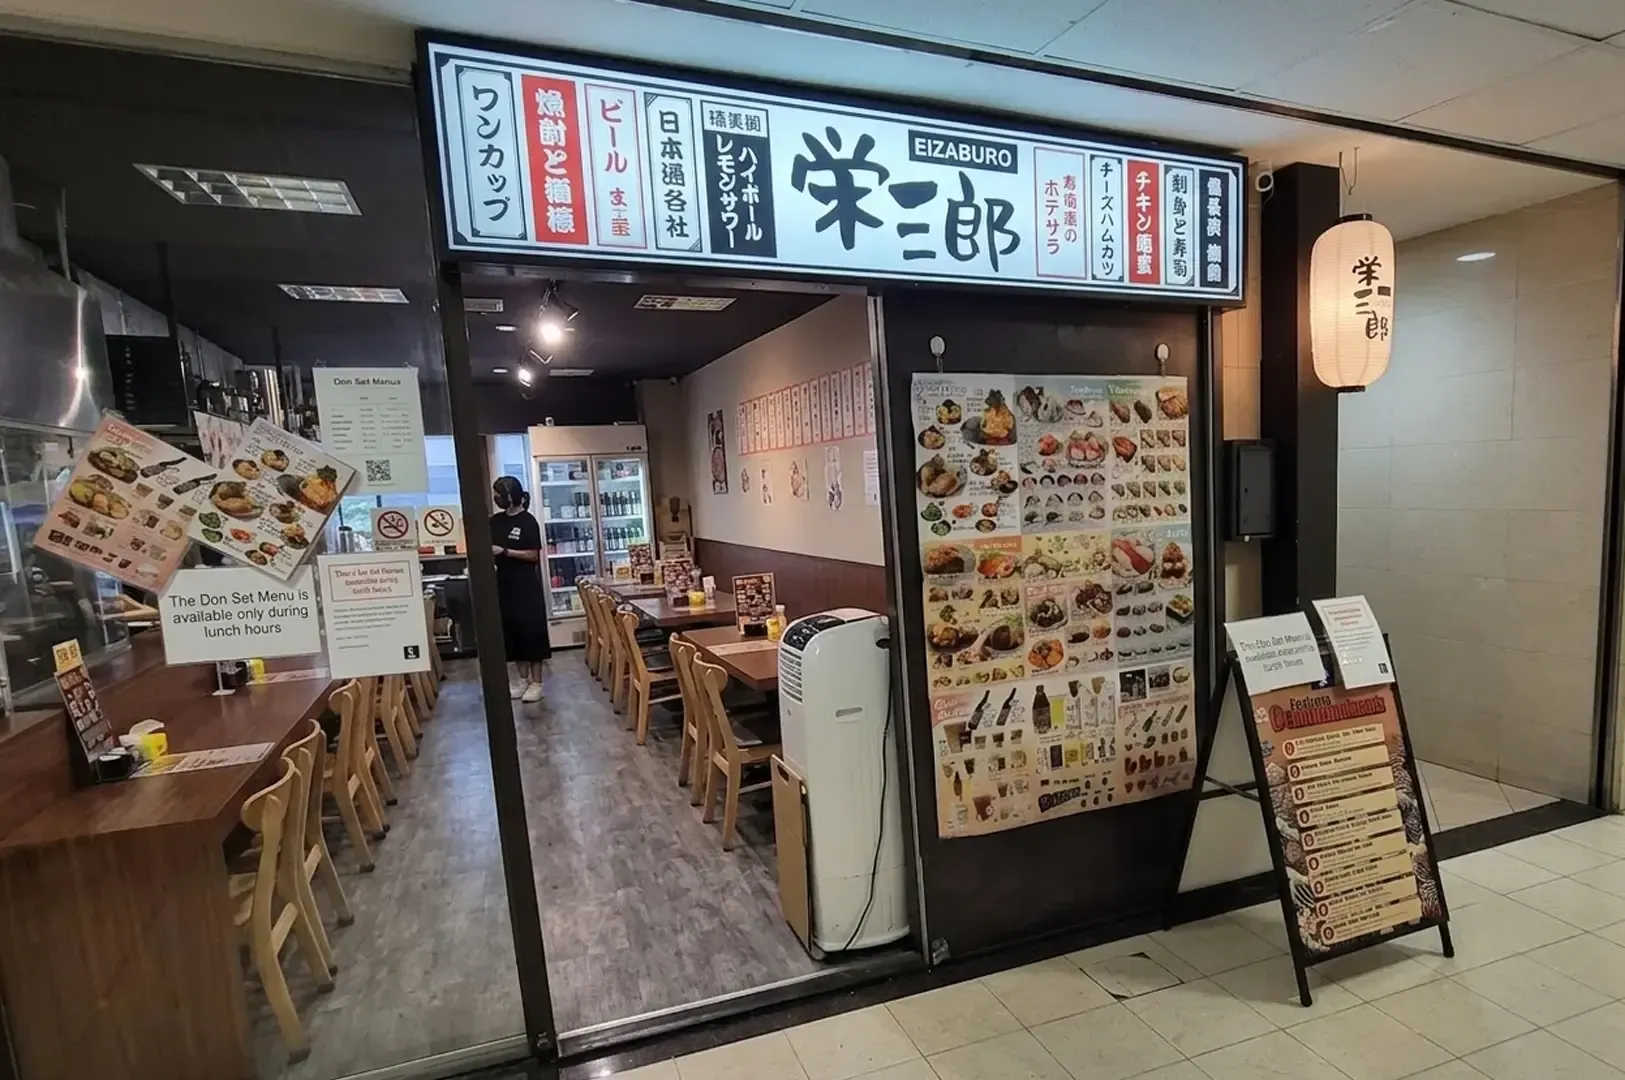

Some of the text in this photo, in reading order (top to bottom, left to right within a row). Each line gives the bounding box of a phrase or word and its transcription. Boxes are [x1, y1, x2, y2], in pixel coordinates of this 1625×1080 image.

[472, 84, 511, 222] ワンカップ
[716, 133, 739, 249] レモンサワー
[738, 147, 763, 241] ハイボール
[791, 126, 1021, 272] 栄三郎
[914, 137, 1012, 168] EIZABURO
[1100, 162, 1114, 276] チーズハムカツ
[168, 589, 309, 607] The Don Set Menu is
[173, 605, 309, 624] available only during
[204, 623, 282, 638] lunch hours
